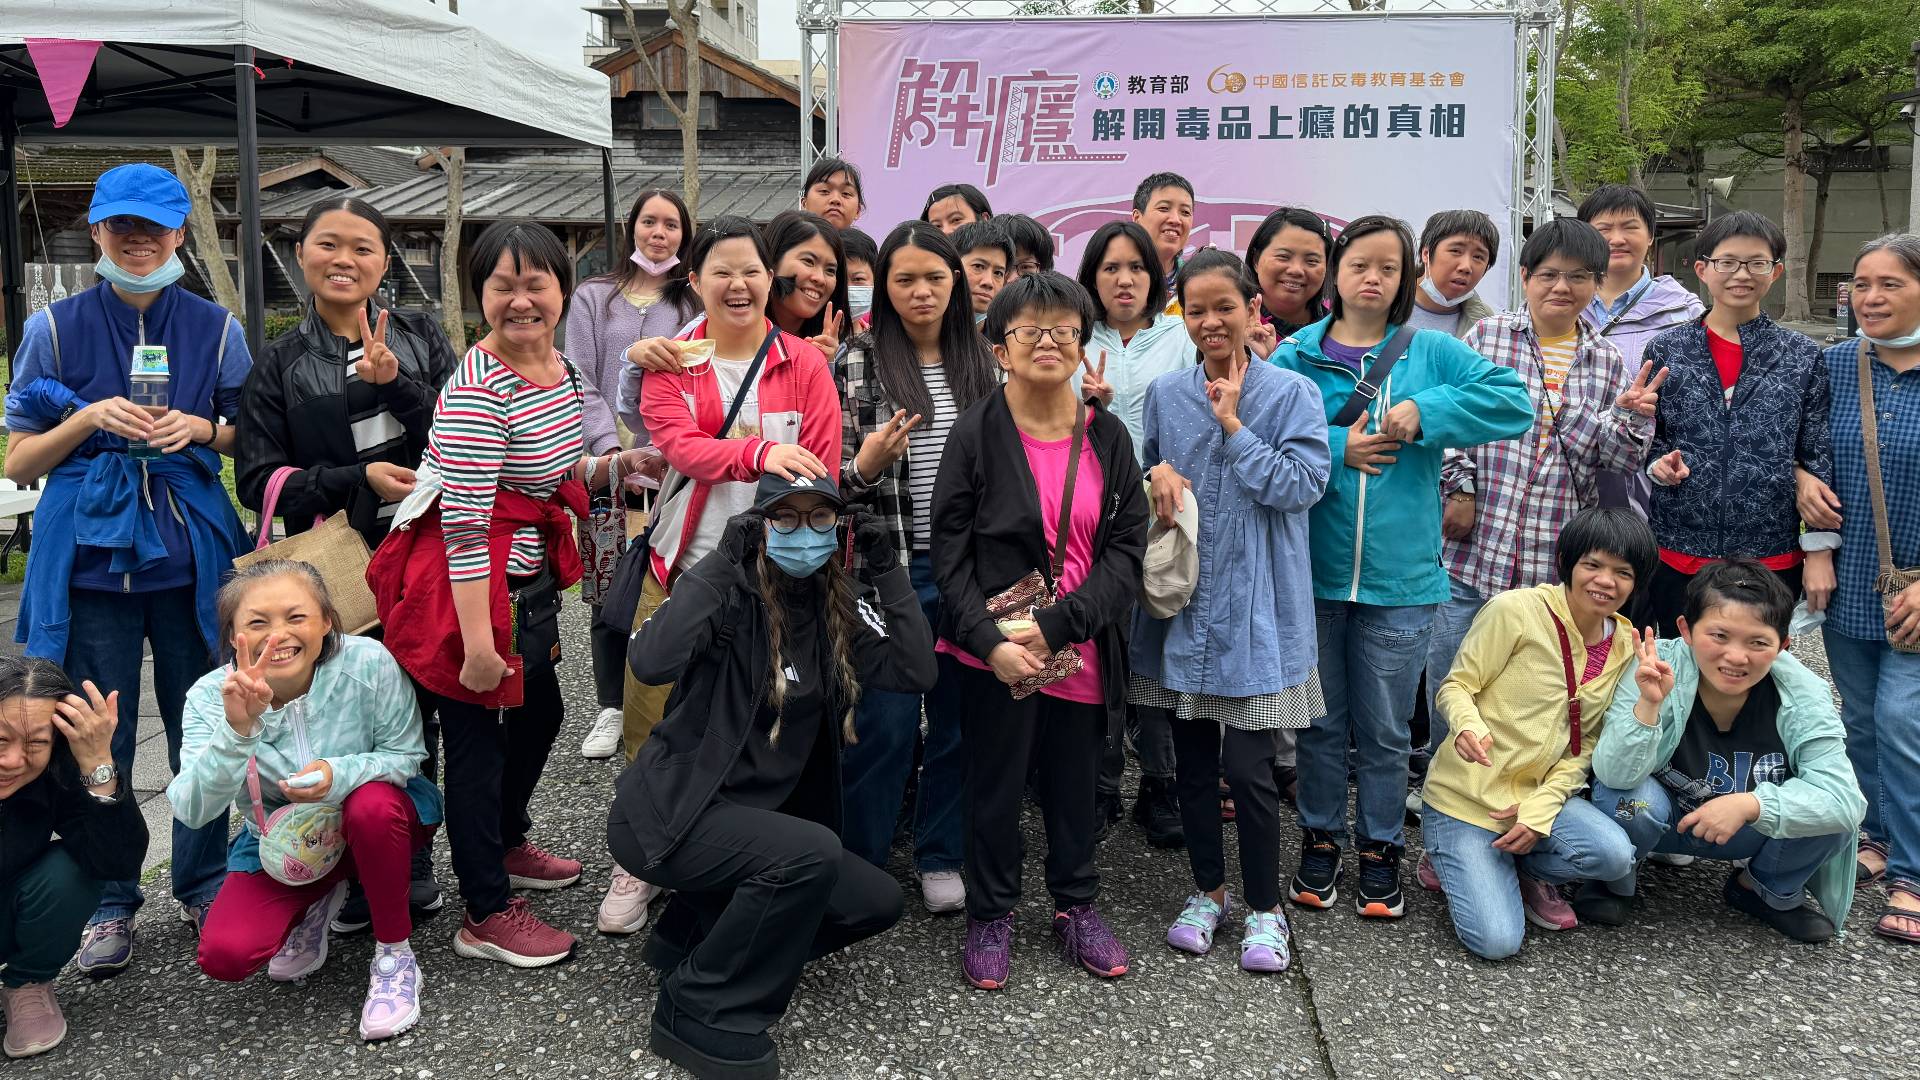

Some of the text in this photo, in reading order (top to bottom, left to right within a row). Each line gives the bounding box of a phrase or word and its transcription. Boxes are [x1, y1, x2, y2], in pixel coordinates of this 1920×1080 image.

[1127, 75, 1190, 95] 教育部
[1253, 71, 1466, 89] 中國信託反毒教育基金會
[886, 58, 1128, 187] 解癮
[1091, 103, 1466, 142] 解開毒品上癮的真相
[1705, 751, 1786, 794] BIG
